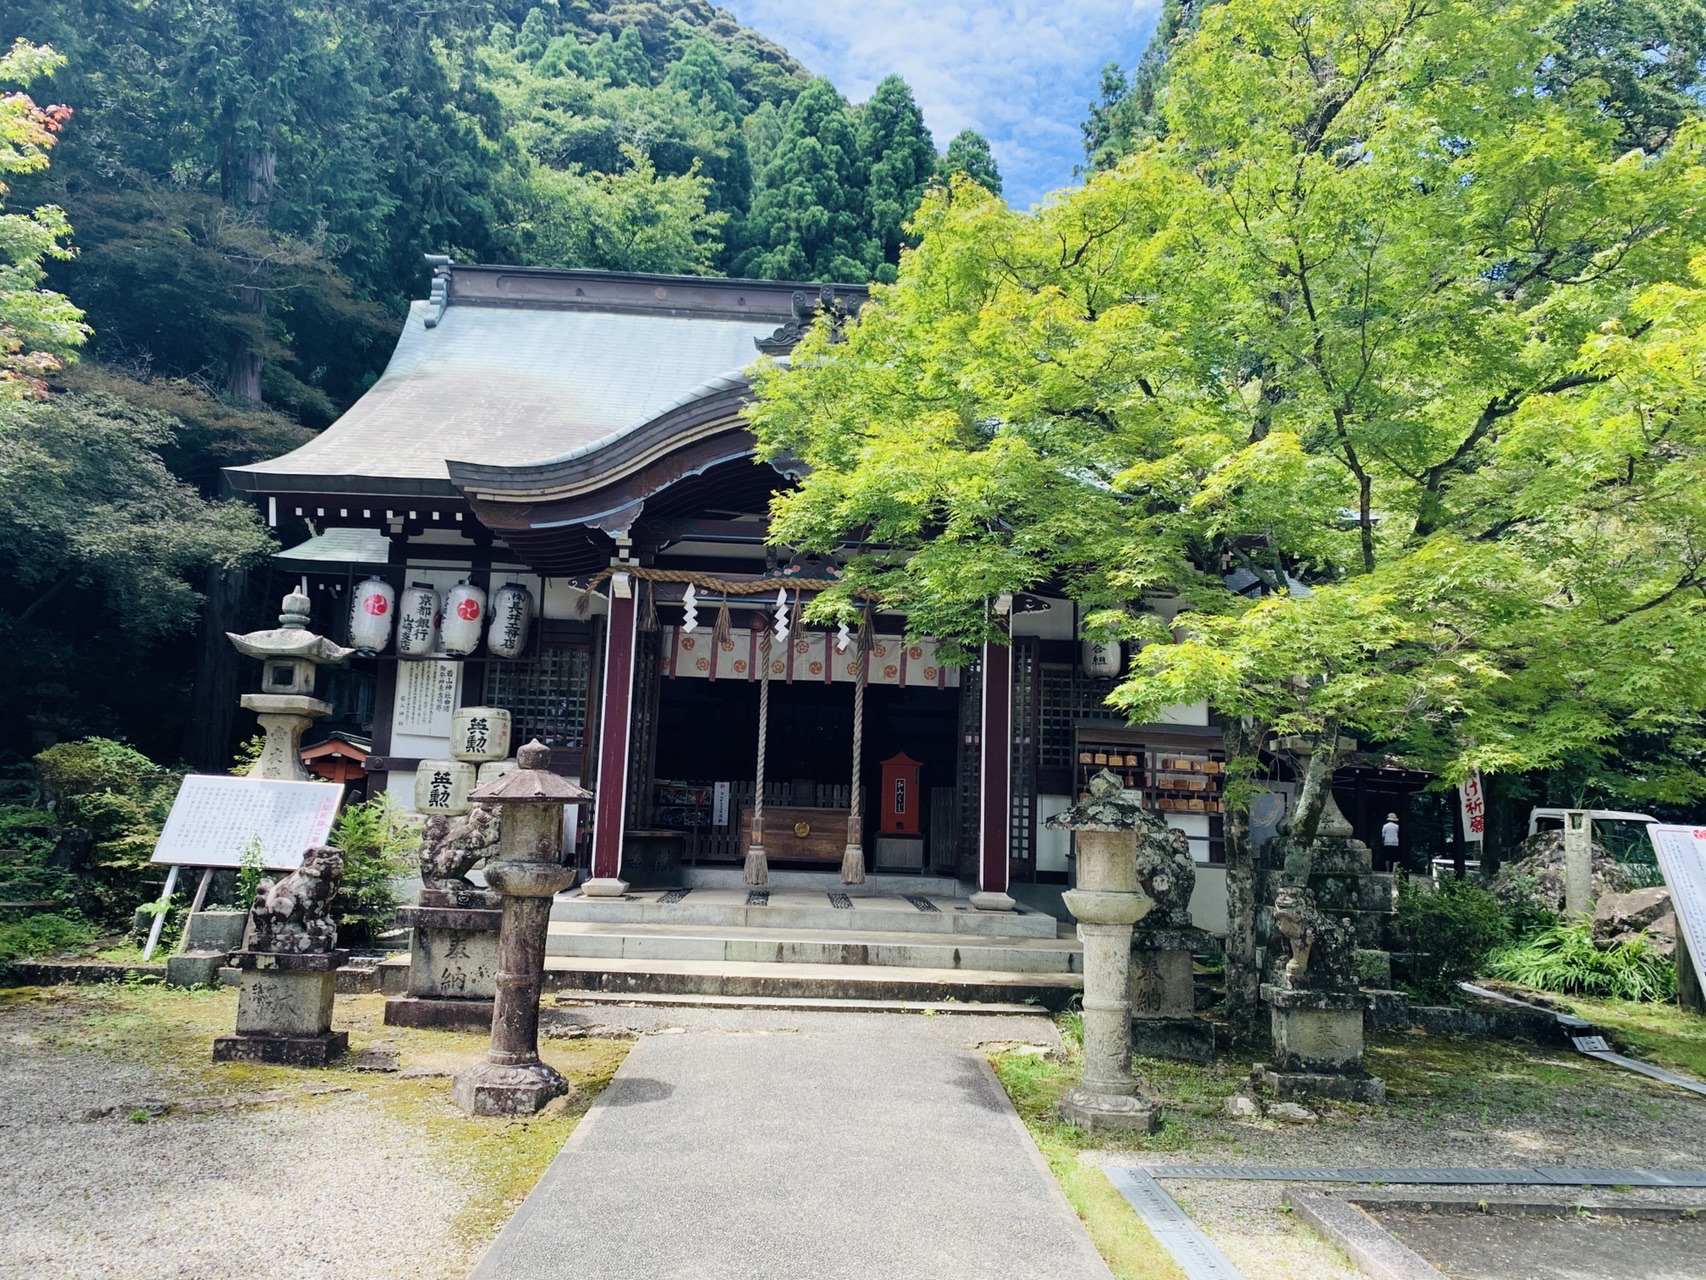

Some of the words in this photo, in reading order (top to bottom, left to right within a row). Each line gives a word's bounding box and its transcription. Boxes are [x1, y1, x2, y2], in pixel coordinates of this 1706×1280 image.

[400, 614, 414, 650] 山崎支店
[414, 594, 432, 641] 京都銀行
[466, 717, 489, 754] 英勲
[429, 771, 453, 808] 英勲
[896, 781, 904, 812] おみくじ
[1464, 770, 1485, 834] け祈願
[440, 936, 471, 992] 奉納
[1137, 955, 1164, 1012] 奉納
